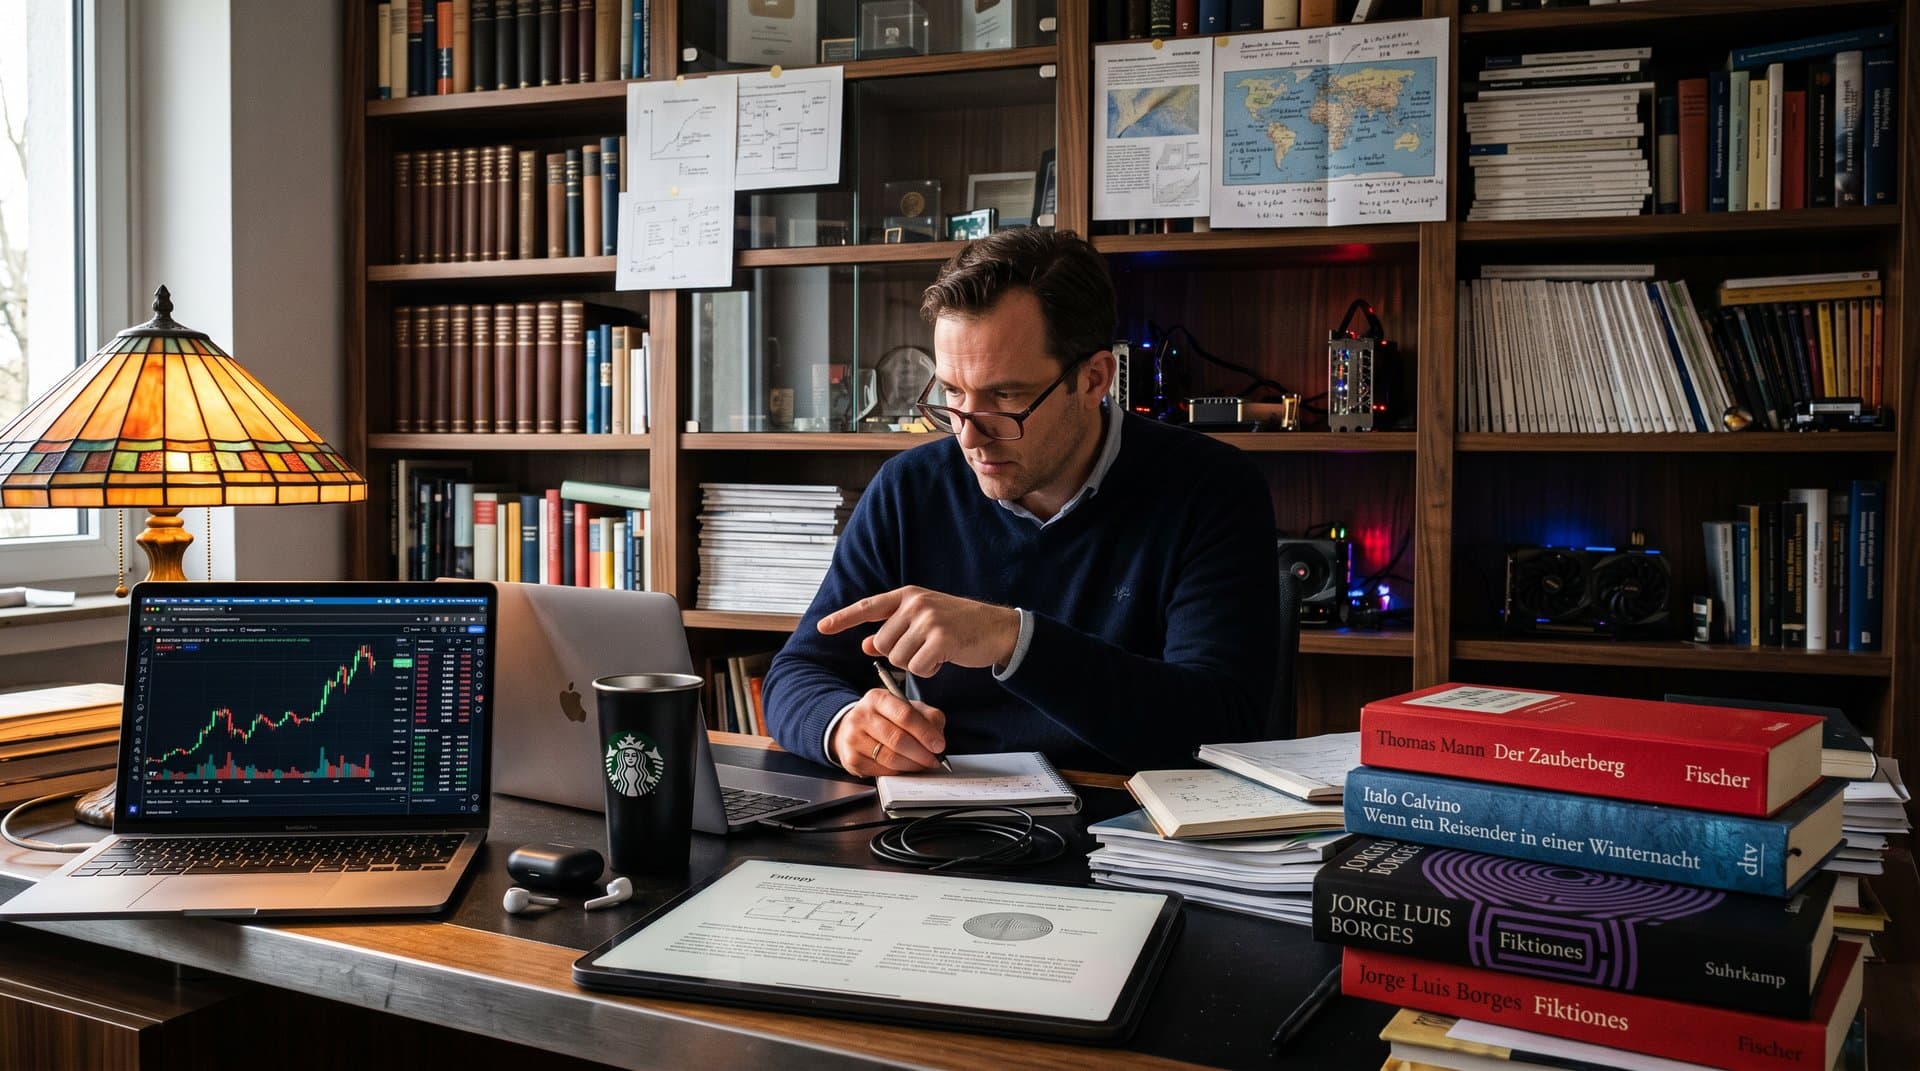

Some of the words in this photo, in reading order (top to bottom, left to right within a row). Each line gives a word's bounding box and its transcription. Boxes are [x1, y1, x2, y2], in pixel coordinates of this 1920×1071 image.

[1376, 729, 1436, 751] Thomas
[1441, 737, 1485, 757] Mann
[1494, 743, 1525, 762] Der
[1528, 747, 1625, 779] Zauberberg
[1685, 764, 1750, 788] Fischer
[1363, 786, 1397, 805] Italo
[1401, 791, 1461, 814] Calvino
[1363, 806, 1407, 827] Wenn
[1411, 814, 1434, 831] ein
[1439, 816, 1517, 843] Reisender
[1521, 828, 1537, 846] in
[1542, 832, 1584, 853] einer
[1589, 838, 1701, 869] Winternacht
[1736, 843, 1758, 876] dtv
[770, 873, 816, 883] Entropy
[1329, 893, 1397, 919] JORGE
[1403, 903, 1452, 927] LUIS
[1331, 916, 1414, 945] BORGES
[1500, 931, 1583, 960] Fiktiones
[1360, 964, 1406, 993] Jorge
[1410, 973, 1450, 998] Luis
[1457, 981, 1522, 1013] Borges
[1705, 961, 1786, 989] Suhrkamp
[1534, 994, 1629, 1031] Fiktiones
[1737, 1033, 1804, 1062] Fischer
